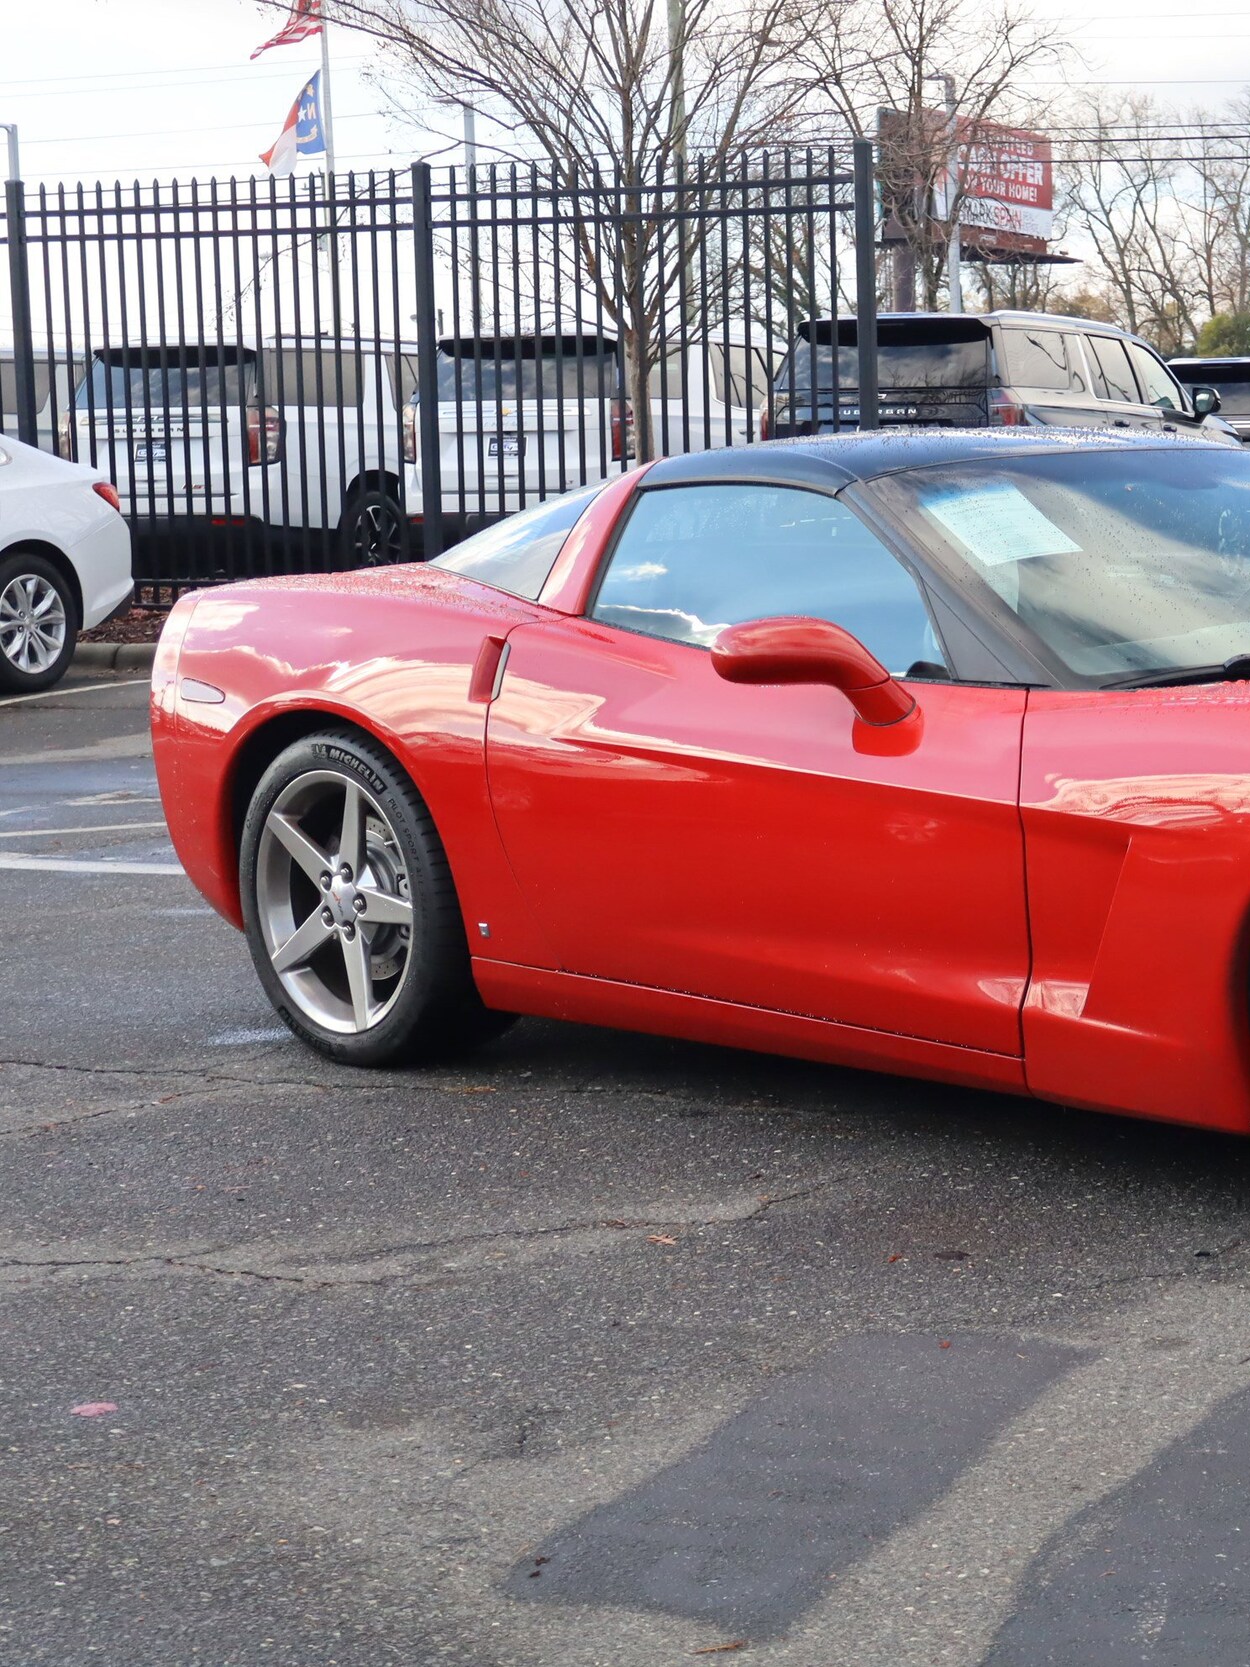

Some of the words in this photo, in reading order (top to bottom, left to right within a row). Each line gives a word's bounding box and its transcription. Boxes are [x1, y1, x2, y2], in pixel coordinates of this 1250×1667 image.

[1000, 152, 1044, 186] OFFER
[980, 176, 1006, 197] YOUR
[1008, 182, 1038, 203] HOME!
[329, 748, 384, 791] MICHELIN
[388, 798, 406, 824] PILOT
[403, 827, 420, 862] SPORT
